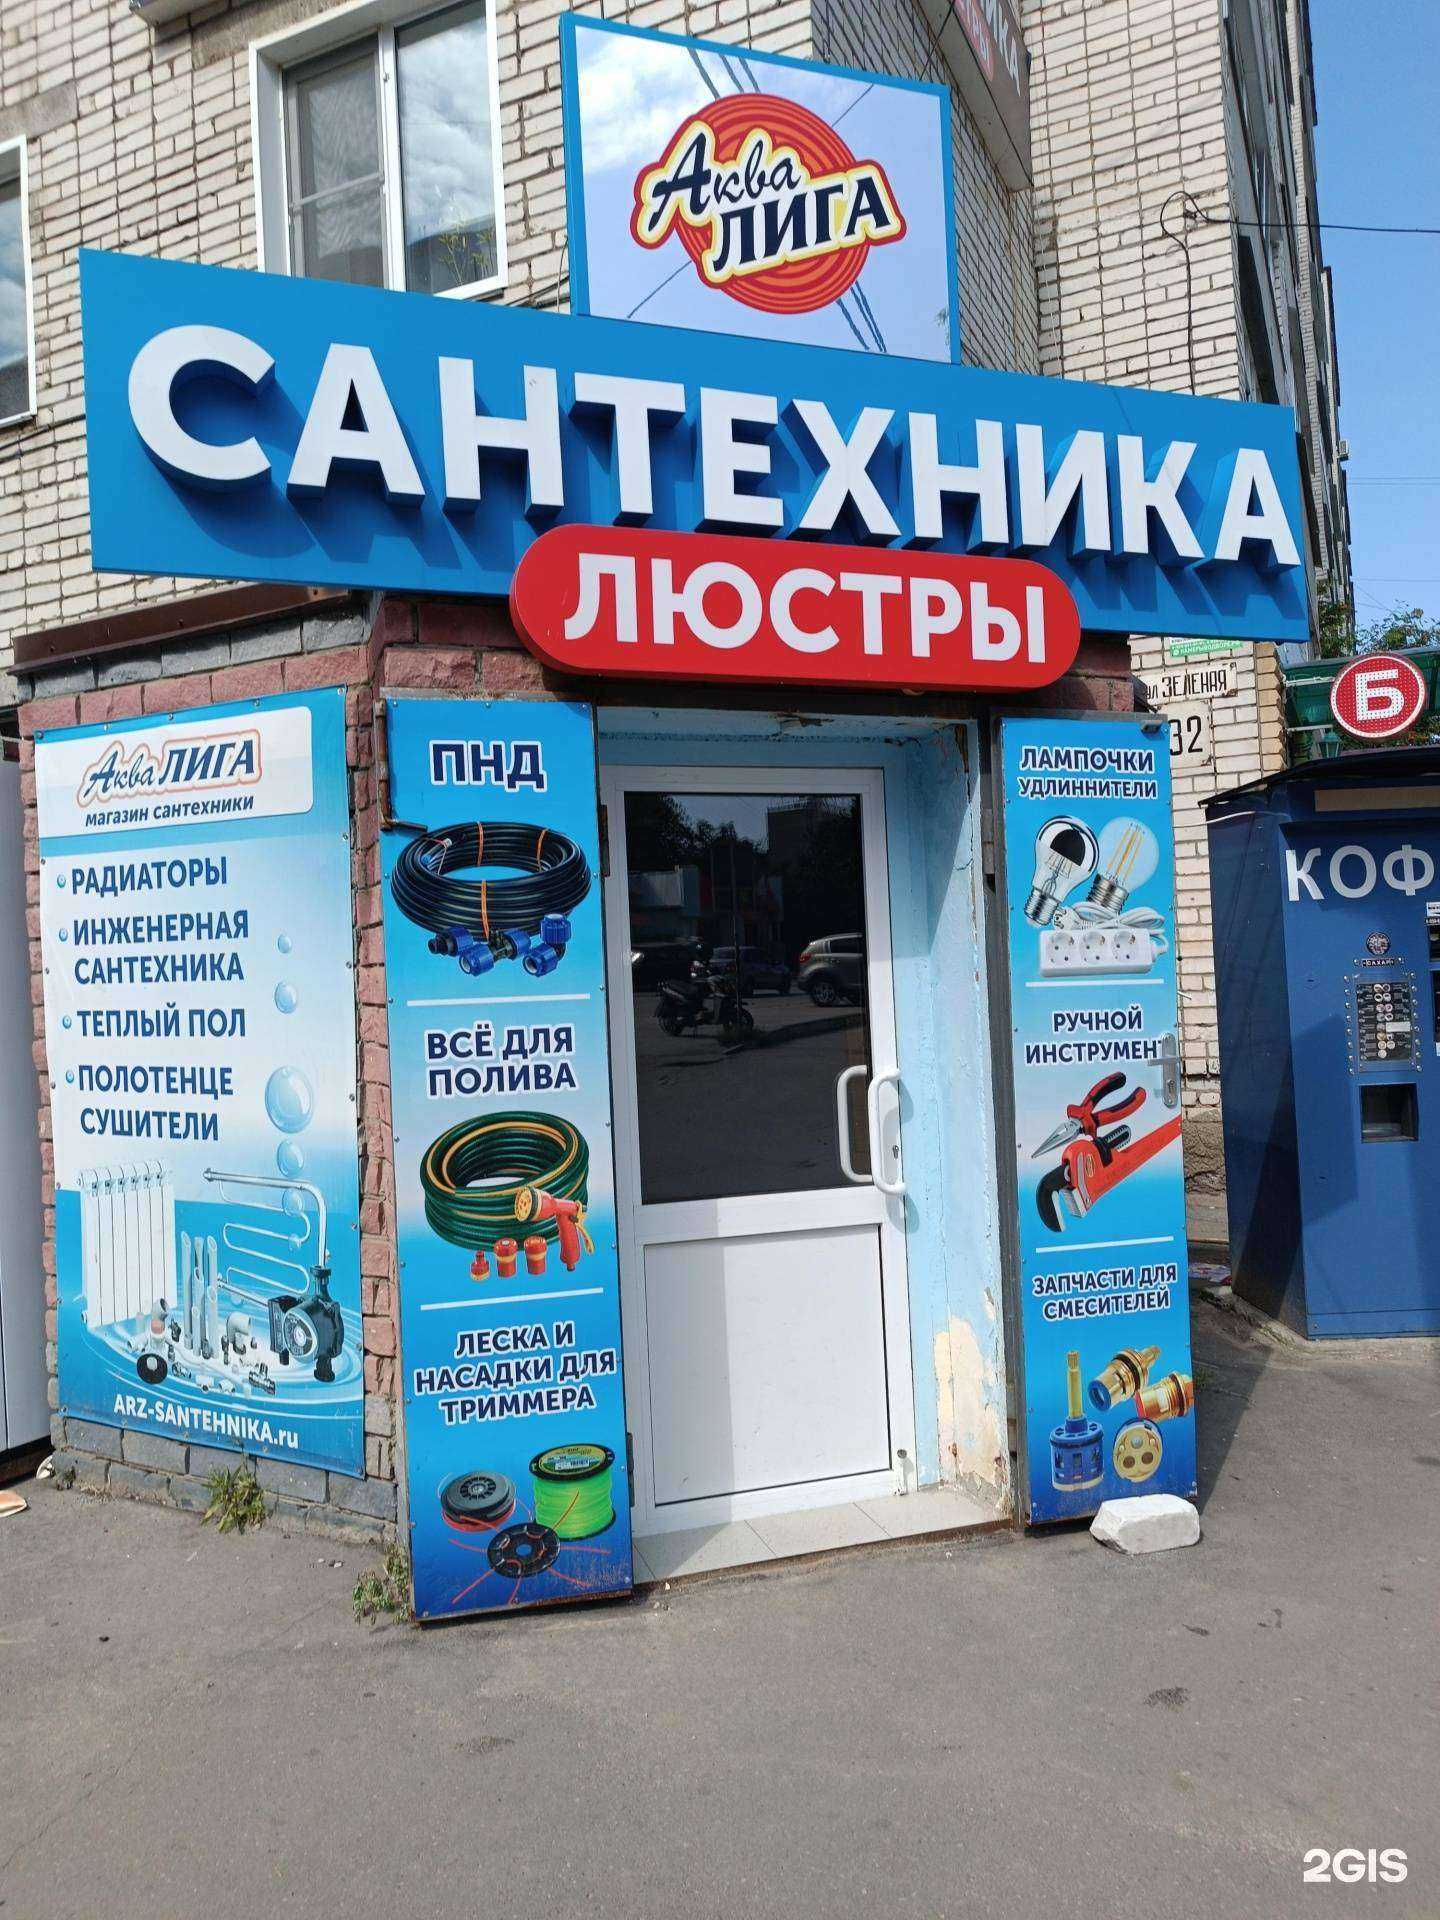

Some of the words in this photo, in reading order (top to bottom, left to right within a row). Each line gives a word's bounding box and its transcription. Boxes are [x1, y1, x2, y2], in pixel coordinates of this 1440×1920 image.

[649, 132, 801, 232] Аква
[712, 177, 891, 271] ЛИГА
[128, 324, 1301, 567] САНТЕХНИКА
[564, 552, 1047, 664] ЛЮСТРЫ
[1162, 669, 1227, 698] ЗЕЛЕНАЯ
[1355, 668, 1405, 722] Б
[1168, 715, 1203, 756] 32
[83, 749, 155, 798] Аква
[158, 739, 255, 785] ЛИГА
[431, 742, 547, 791] ПНД
[1020, 747, 1154, 773] ЛАМПОЧКИ
[1018, 778, 1158, 799] УДЛИННИТЕЛИ
[85, 806, 149, 828] магазин
[153, 795, 254, 820] сантехники
[71, 856, 228, 897] РАДИАТОРЫ
[1285, 844, 1435, 901] КОФ
[73, 909, 249, 947] ИНЖЕНЕРНАЯ
[74, 952, 245, 986] САНТЕХНИКА
[77, 1001, 180, 1039] ТЕПЛЫЙ
[188, 1008, 247, 1038] ПОЛ
[1053, 1005, 1143, 1033] РУЧНОЙ
[427, 1023, 493, 1060] ВСЁ
[502, 1026, 573, 1062] ДЛЯ
[78, 1064, 234, 1102] ПОЛОТЕНЦЕ
[429, 1062, 577, 1097] ПОЛИВА
[79, 1106, 219, 1142] СУШИТЕЛИ
[1032, 1268, 1135, 1295] ЗАПЧАСТИ
[1140, 1264, 1177, 1287] ДЛЯ
[1043, 1286, 1170, 1321] СМЕСИТЕЛЕЙ
[456, 1325, 548, 1357] ЛЕСКА
[555, 1322, 574, 1347] И
[416, 1357, 551, 1393] НАСАДКИ
[559, 1350, 616, 1383] ДЛЯ
[113, 1393, 299, 1450] ARZ-SANTEHNIKA.ru
[441, 1385, 595, 1424] ТРИММЕРА
